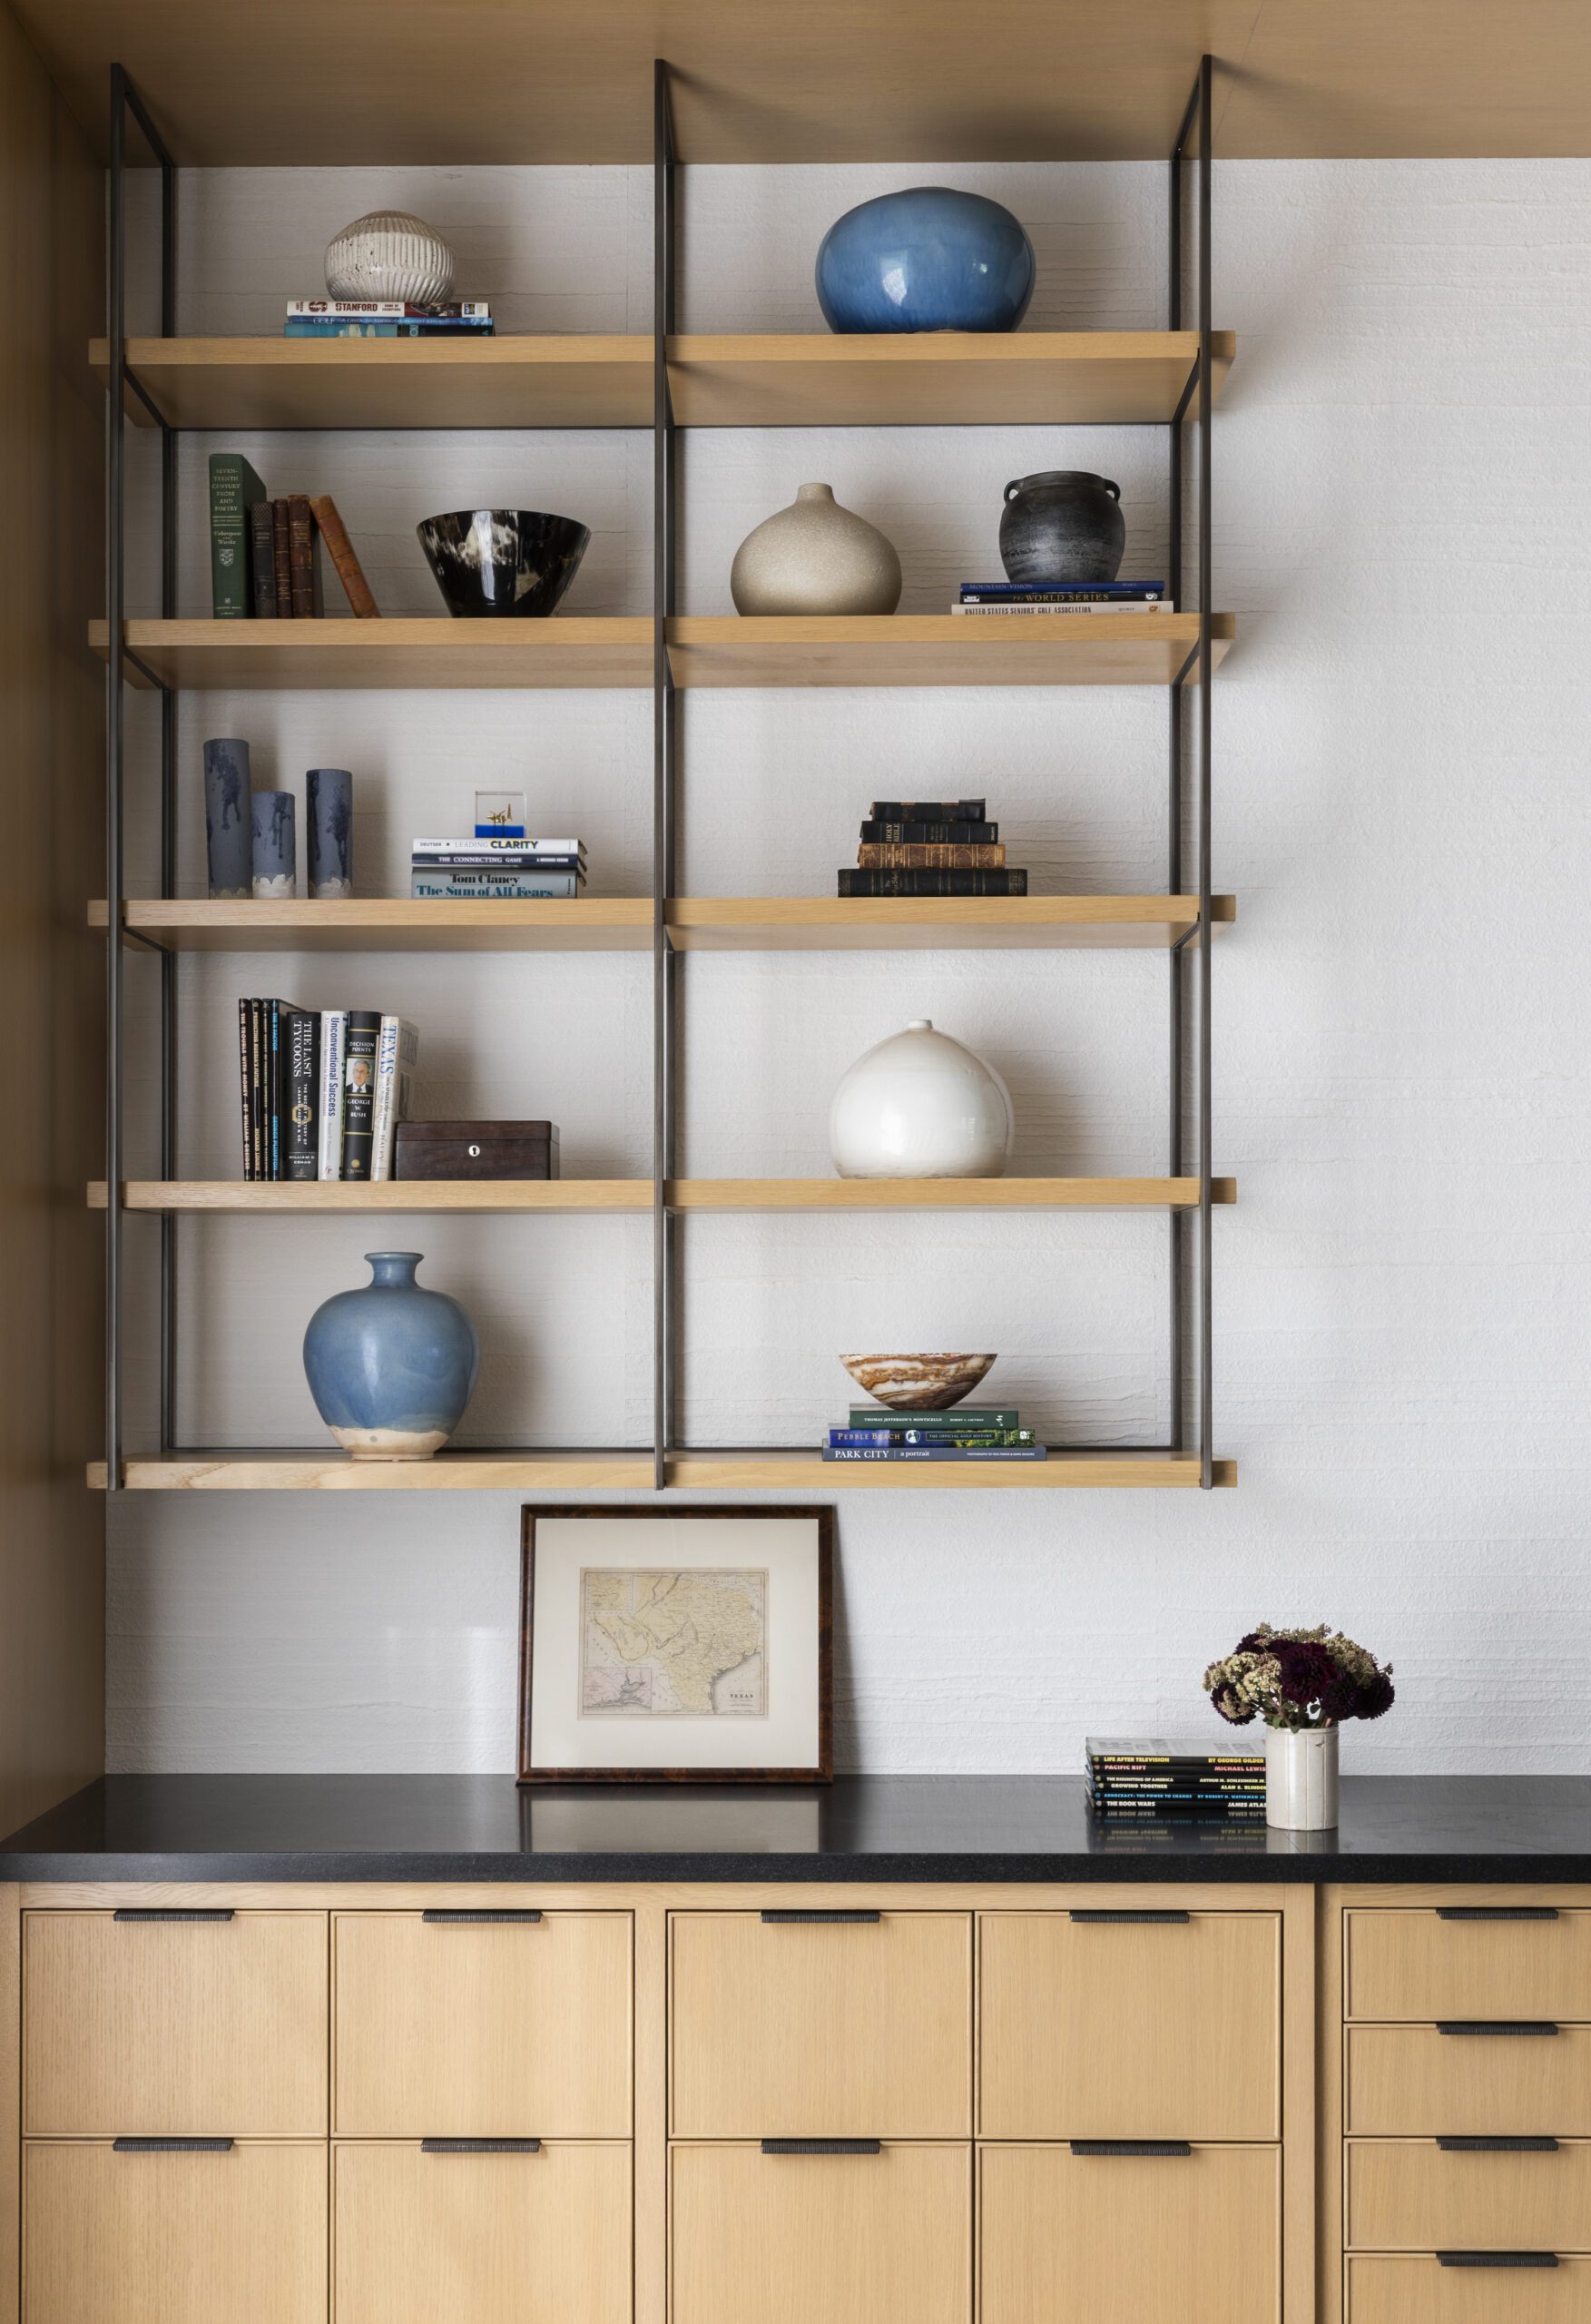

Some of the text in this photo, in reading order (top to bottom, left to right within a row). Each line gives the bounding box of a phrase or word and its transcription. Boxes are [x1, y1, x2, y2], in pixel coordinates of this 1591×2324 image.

[335, 302, 378, 312] STANFORD
[313, 317, 335, 325] GOLF
[1026, 595, 1065, 603] WORLD
[1068, 594, 1109, 602] SERIES
[490, 841, 539, 849] CLARITY
[450, 873, 520, 887] Tom Clancy
[417, 885, 443, 896] The
[446, 885, 475, 896] Sum
[477, 886, 491, 896] of
[493, 886, 513, 897] All
[516, 886, 554, 897] Fears
[293, 1020, 302, 1078] TYCOONS
[303, 1020, 312, 1078] THE LAST
[379, 1026, 398, 1075] TEXAS
[329, 1017, 339, 1117] Unconventional Success
[242, 1103, 249, 1112] BY
[835, 1450, 889, 1459] PARK CITY
[906, 1450, 930, 1458] portrait
